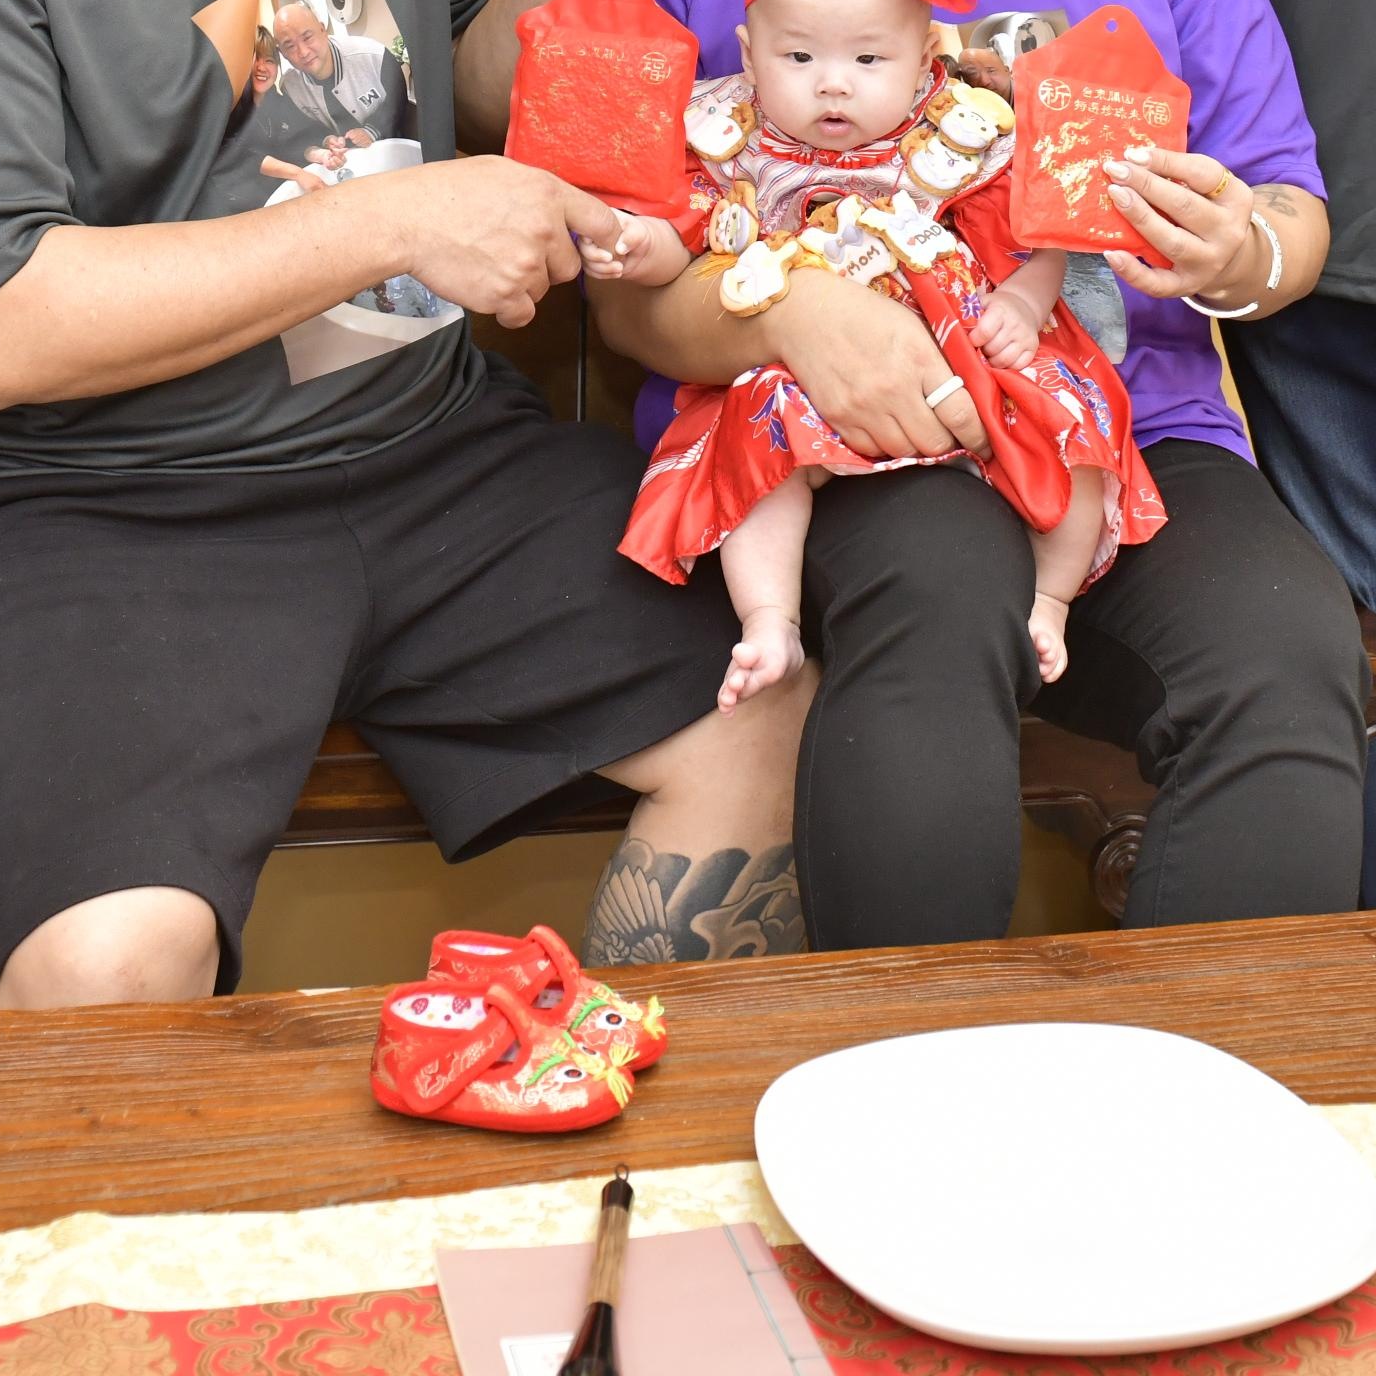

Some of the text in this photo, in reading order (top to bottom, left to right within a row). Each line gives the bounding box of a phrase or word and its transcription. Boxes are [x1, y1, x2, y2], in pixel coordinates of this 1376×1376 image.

[1038, 78, 1072, 111] 祈
[1142, 96, 1172, 128] 福
[915, 224, 942, 244] DAD
[846, 245, 881, 276] MOM
